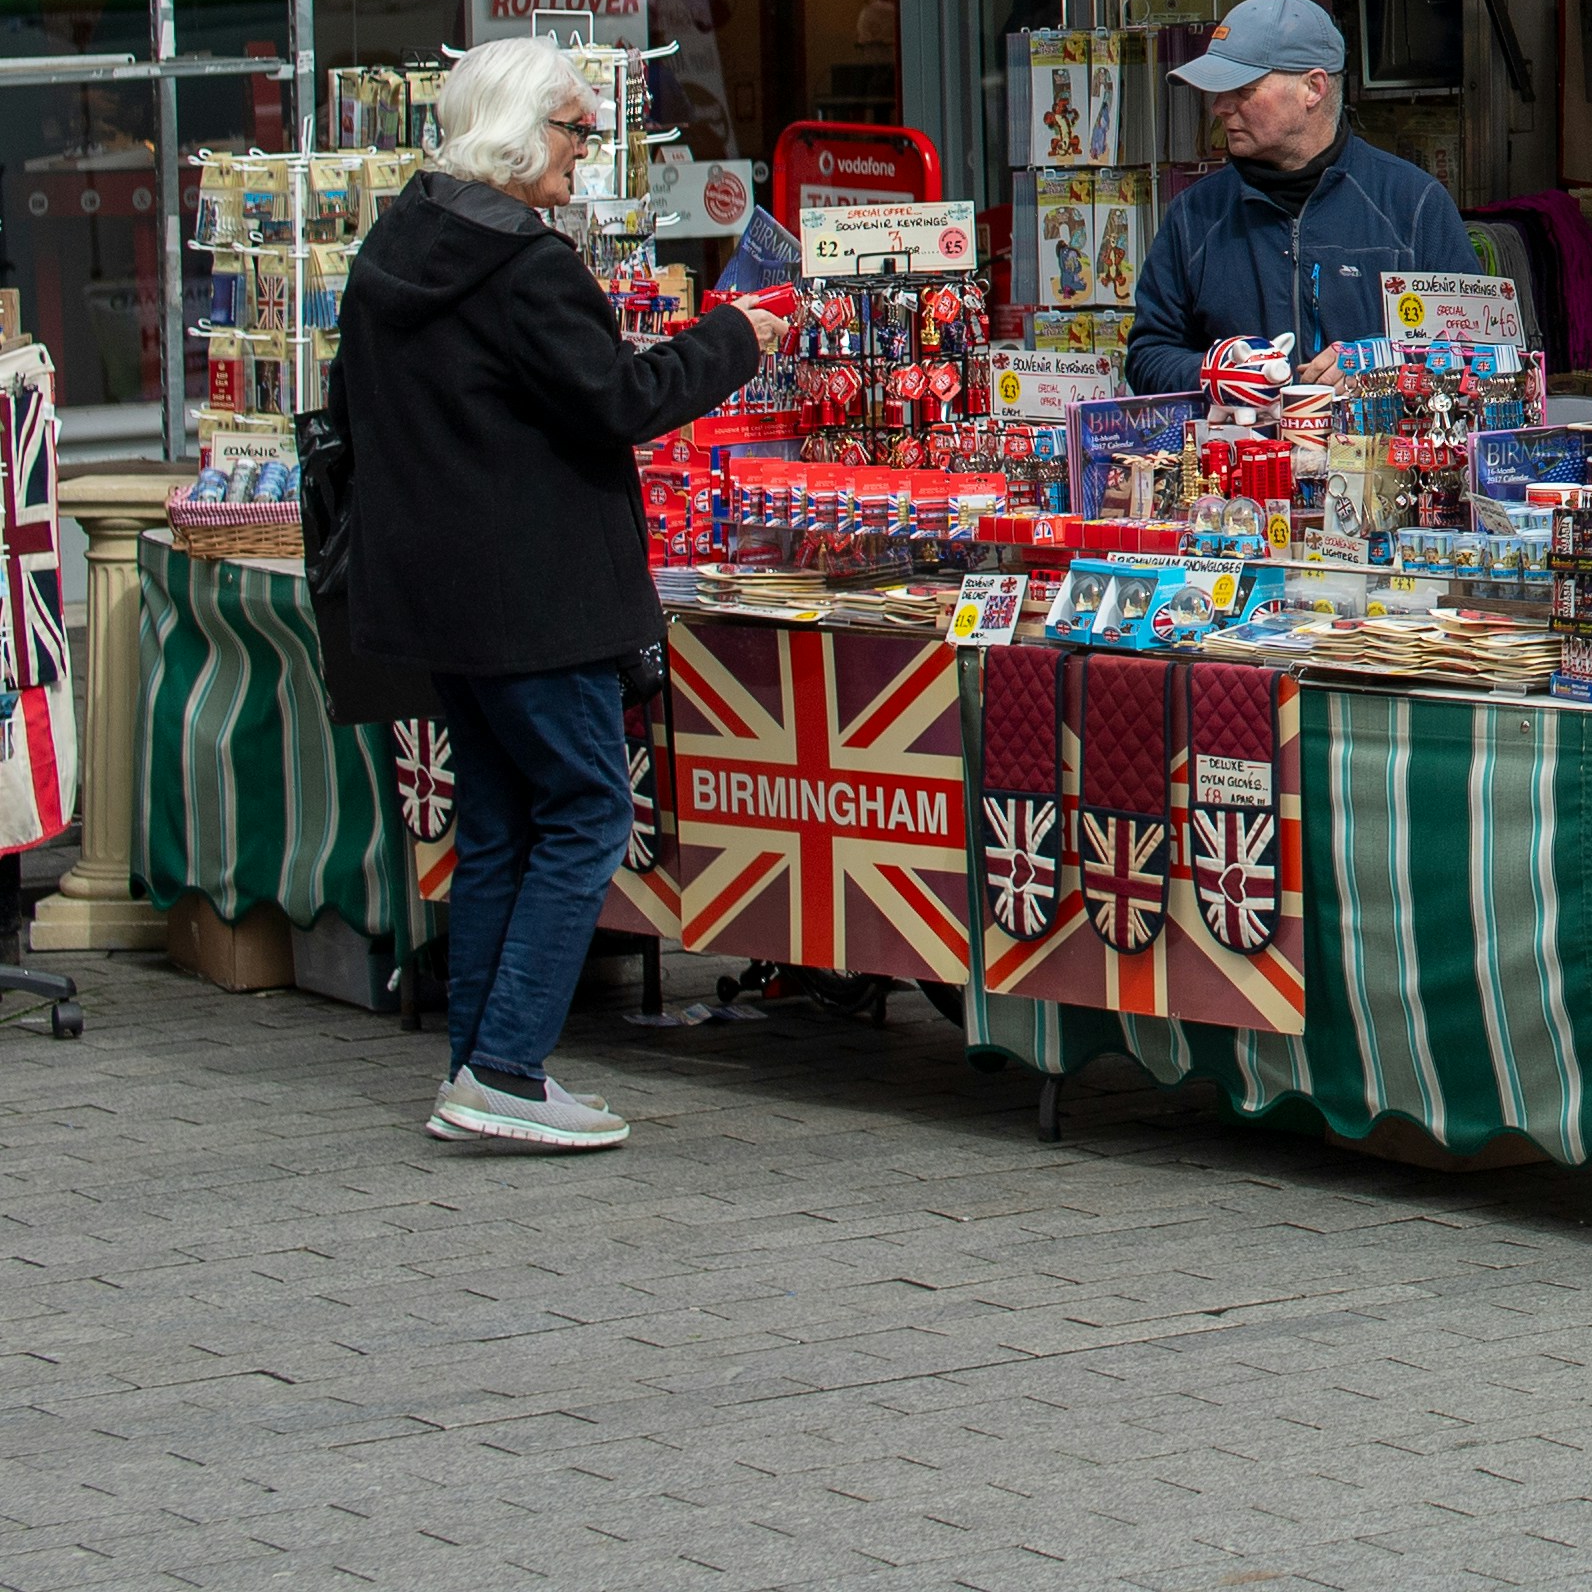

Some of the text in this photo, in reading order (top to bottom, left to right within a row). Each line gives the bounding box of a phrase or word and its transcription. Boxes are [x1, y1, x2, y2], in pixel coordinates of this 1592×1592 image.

[837, 156, 896, 178] vodafone
[815, 239, 839, 258] £2
[944, 240, 963, 255] £5
[1403, 307, 1420, 322] £3
[1003, 386, 1017, 399] £3
[1272, 528, 1287, 545] £3
[1207, 757, 1246, 773] DELUXE
[691, 767, 950, 837] BIRMINGHAM
